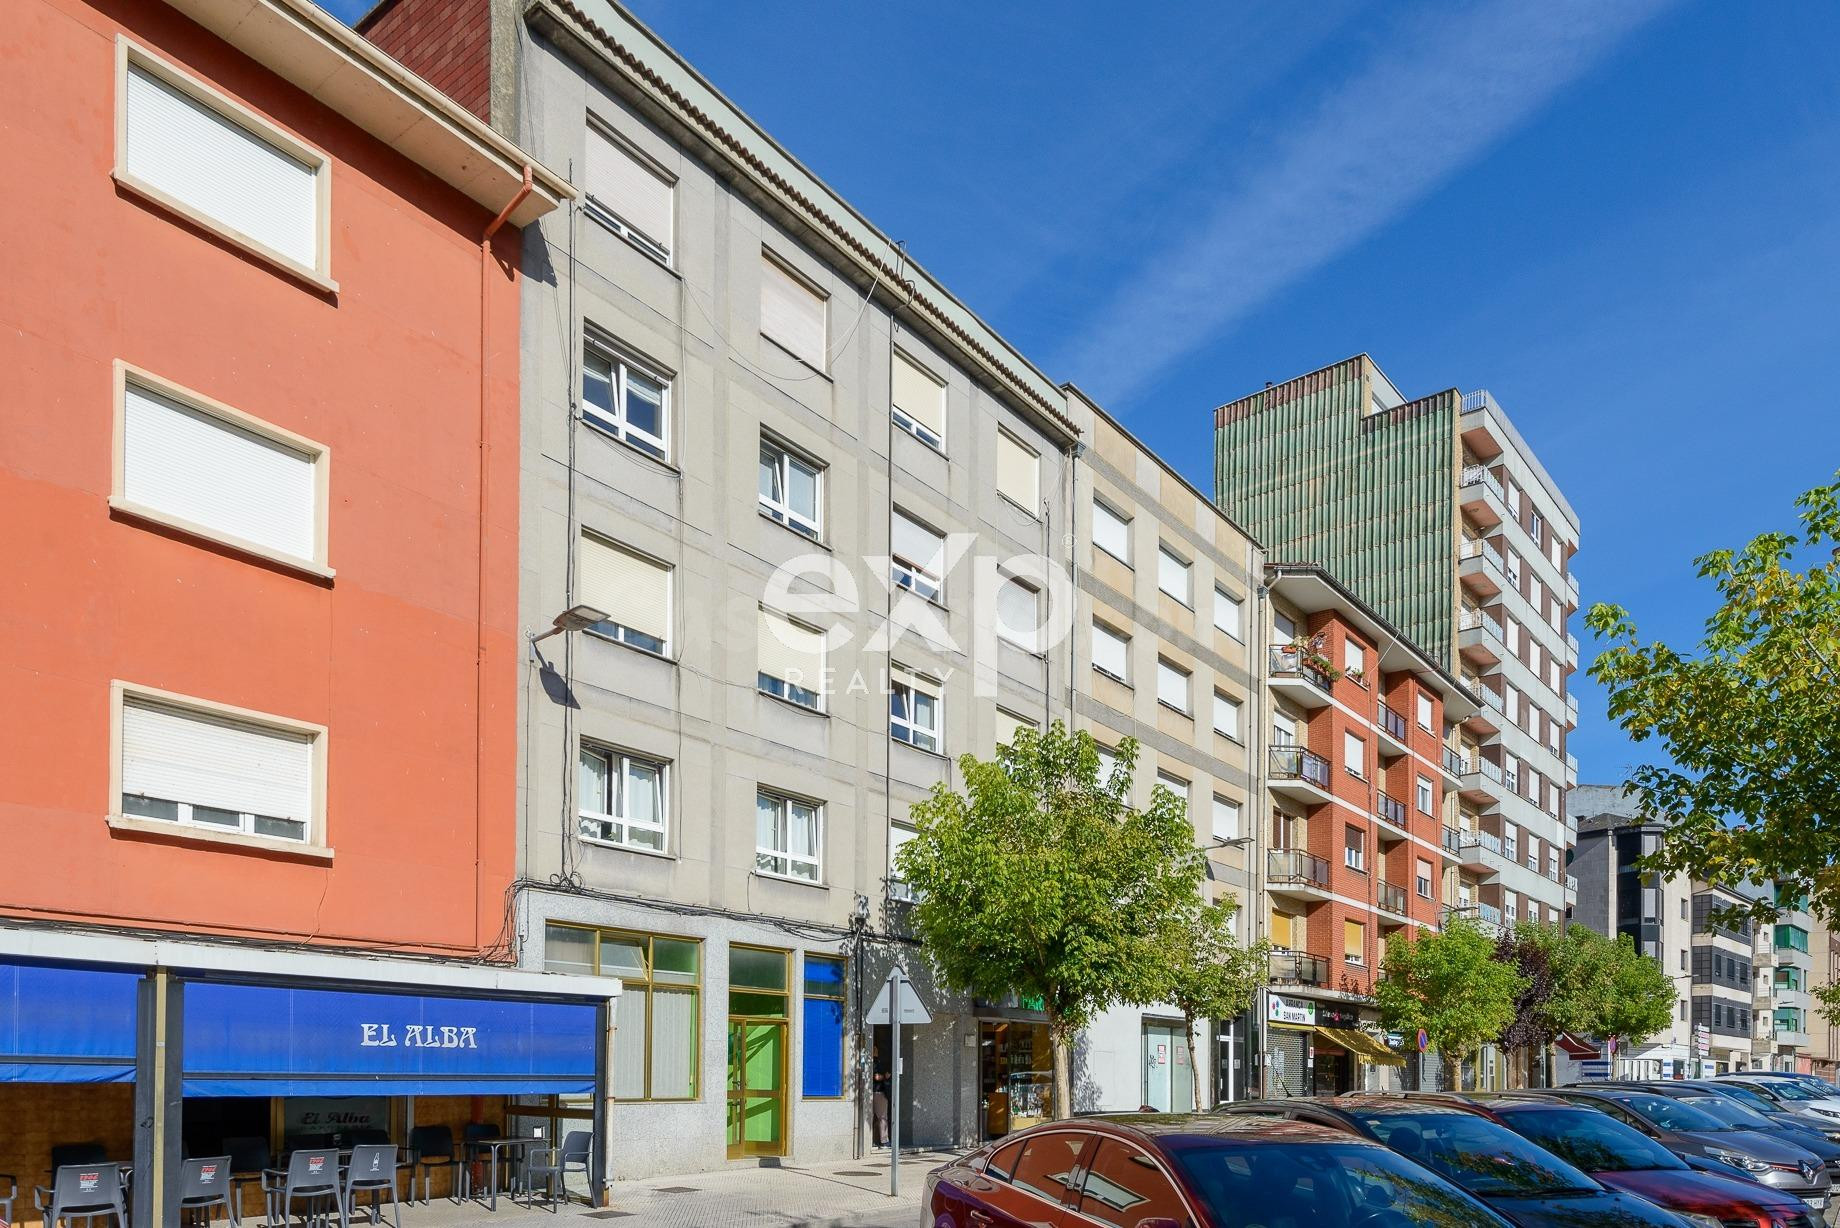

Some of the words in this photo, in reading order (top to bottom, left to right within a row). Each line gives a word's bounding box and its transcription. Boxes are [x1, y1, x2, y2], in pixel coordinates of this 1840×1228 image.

[361, 1023, 398, 1046] EL
[404, 1025, 478, 1049] ALBA
[301, 1112, 320, 1125] El
[325, 1111, 371, 1124] Alba
